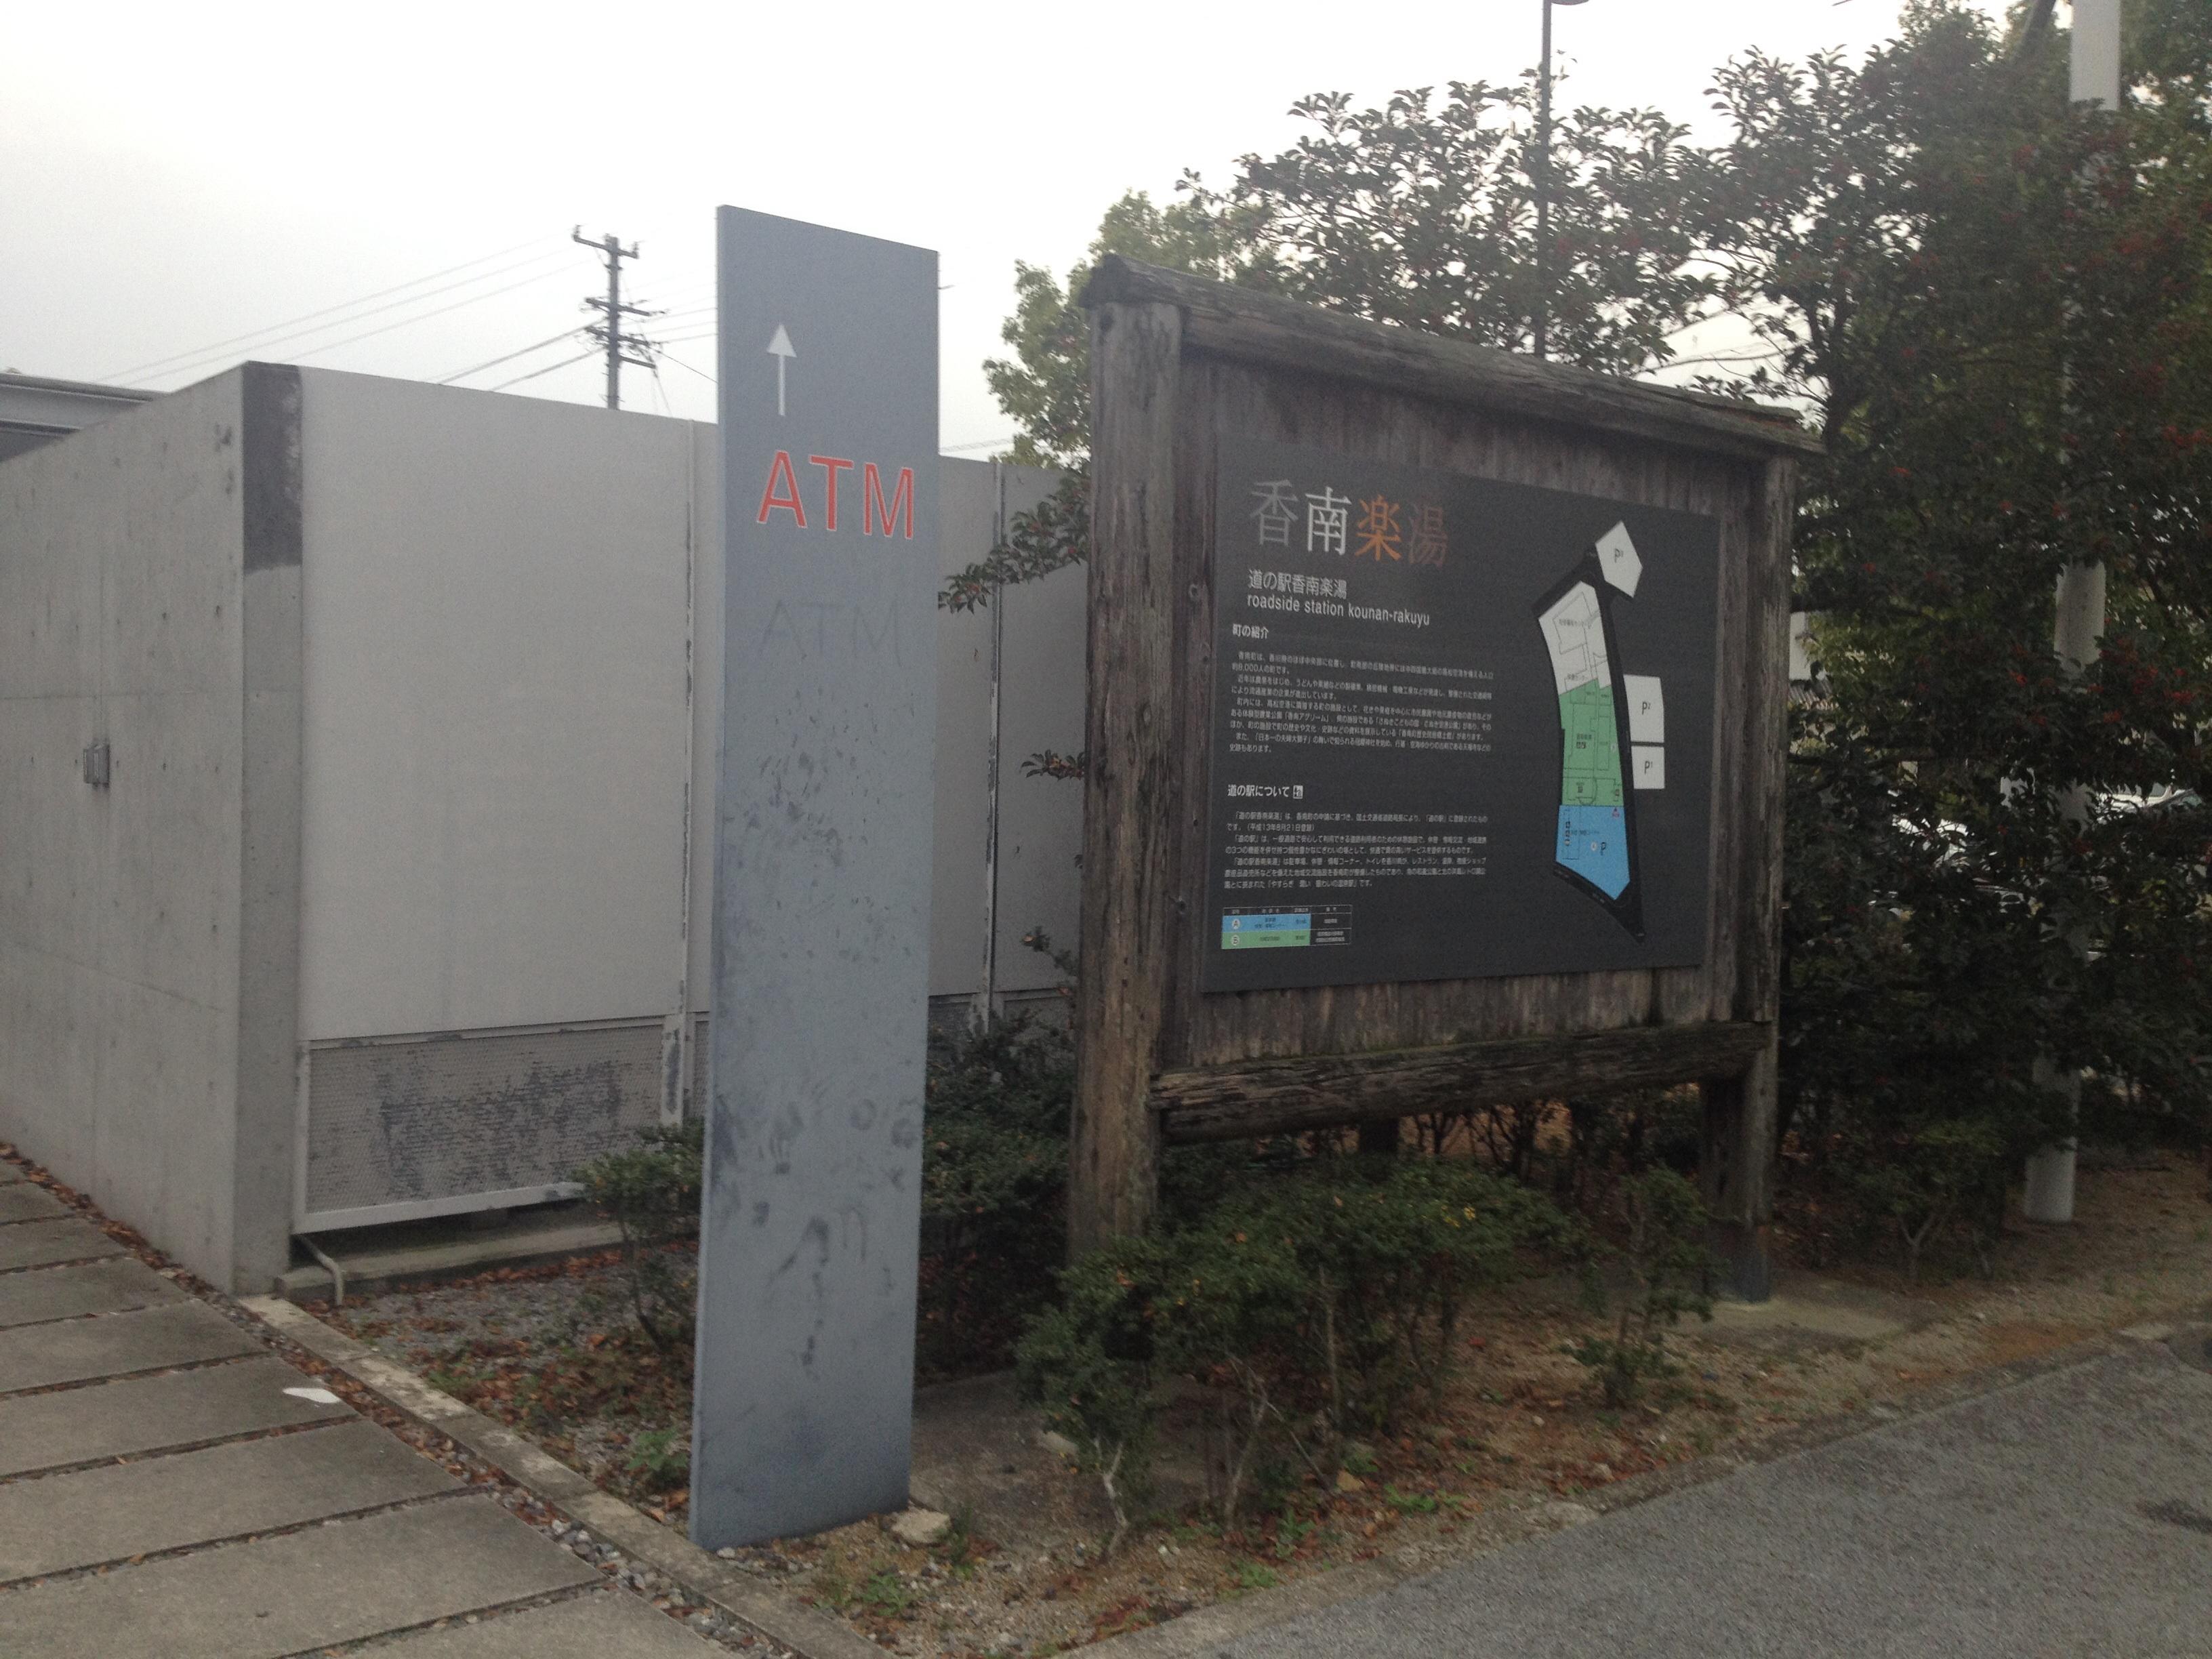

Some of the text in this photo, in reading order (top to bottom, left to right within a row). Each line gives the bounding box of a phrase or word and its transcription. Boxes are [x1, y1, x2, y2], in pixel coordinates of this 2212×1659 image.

[757, 450, 914, 539] ATM
[1249, 479, 1448, 567] 香南楽湯
[1247, 569, 1347, 600] 道の駅香南楽湯
[1247, 594, 1431, 629] roadside station kounan-rakuyu
[760, 598, 903, 668] ATM
[1232, 623, 1269, 639] 町の紹介
[1227, 784, 1290, 798] 道の駅について
